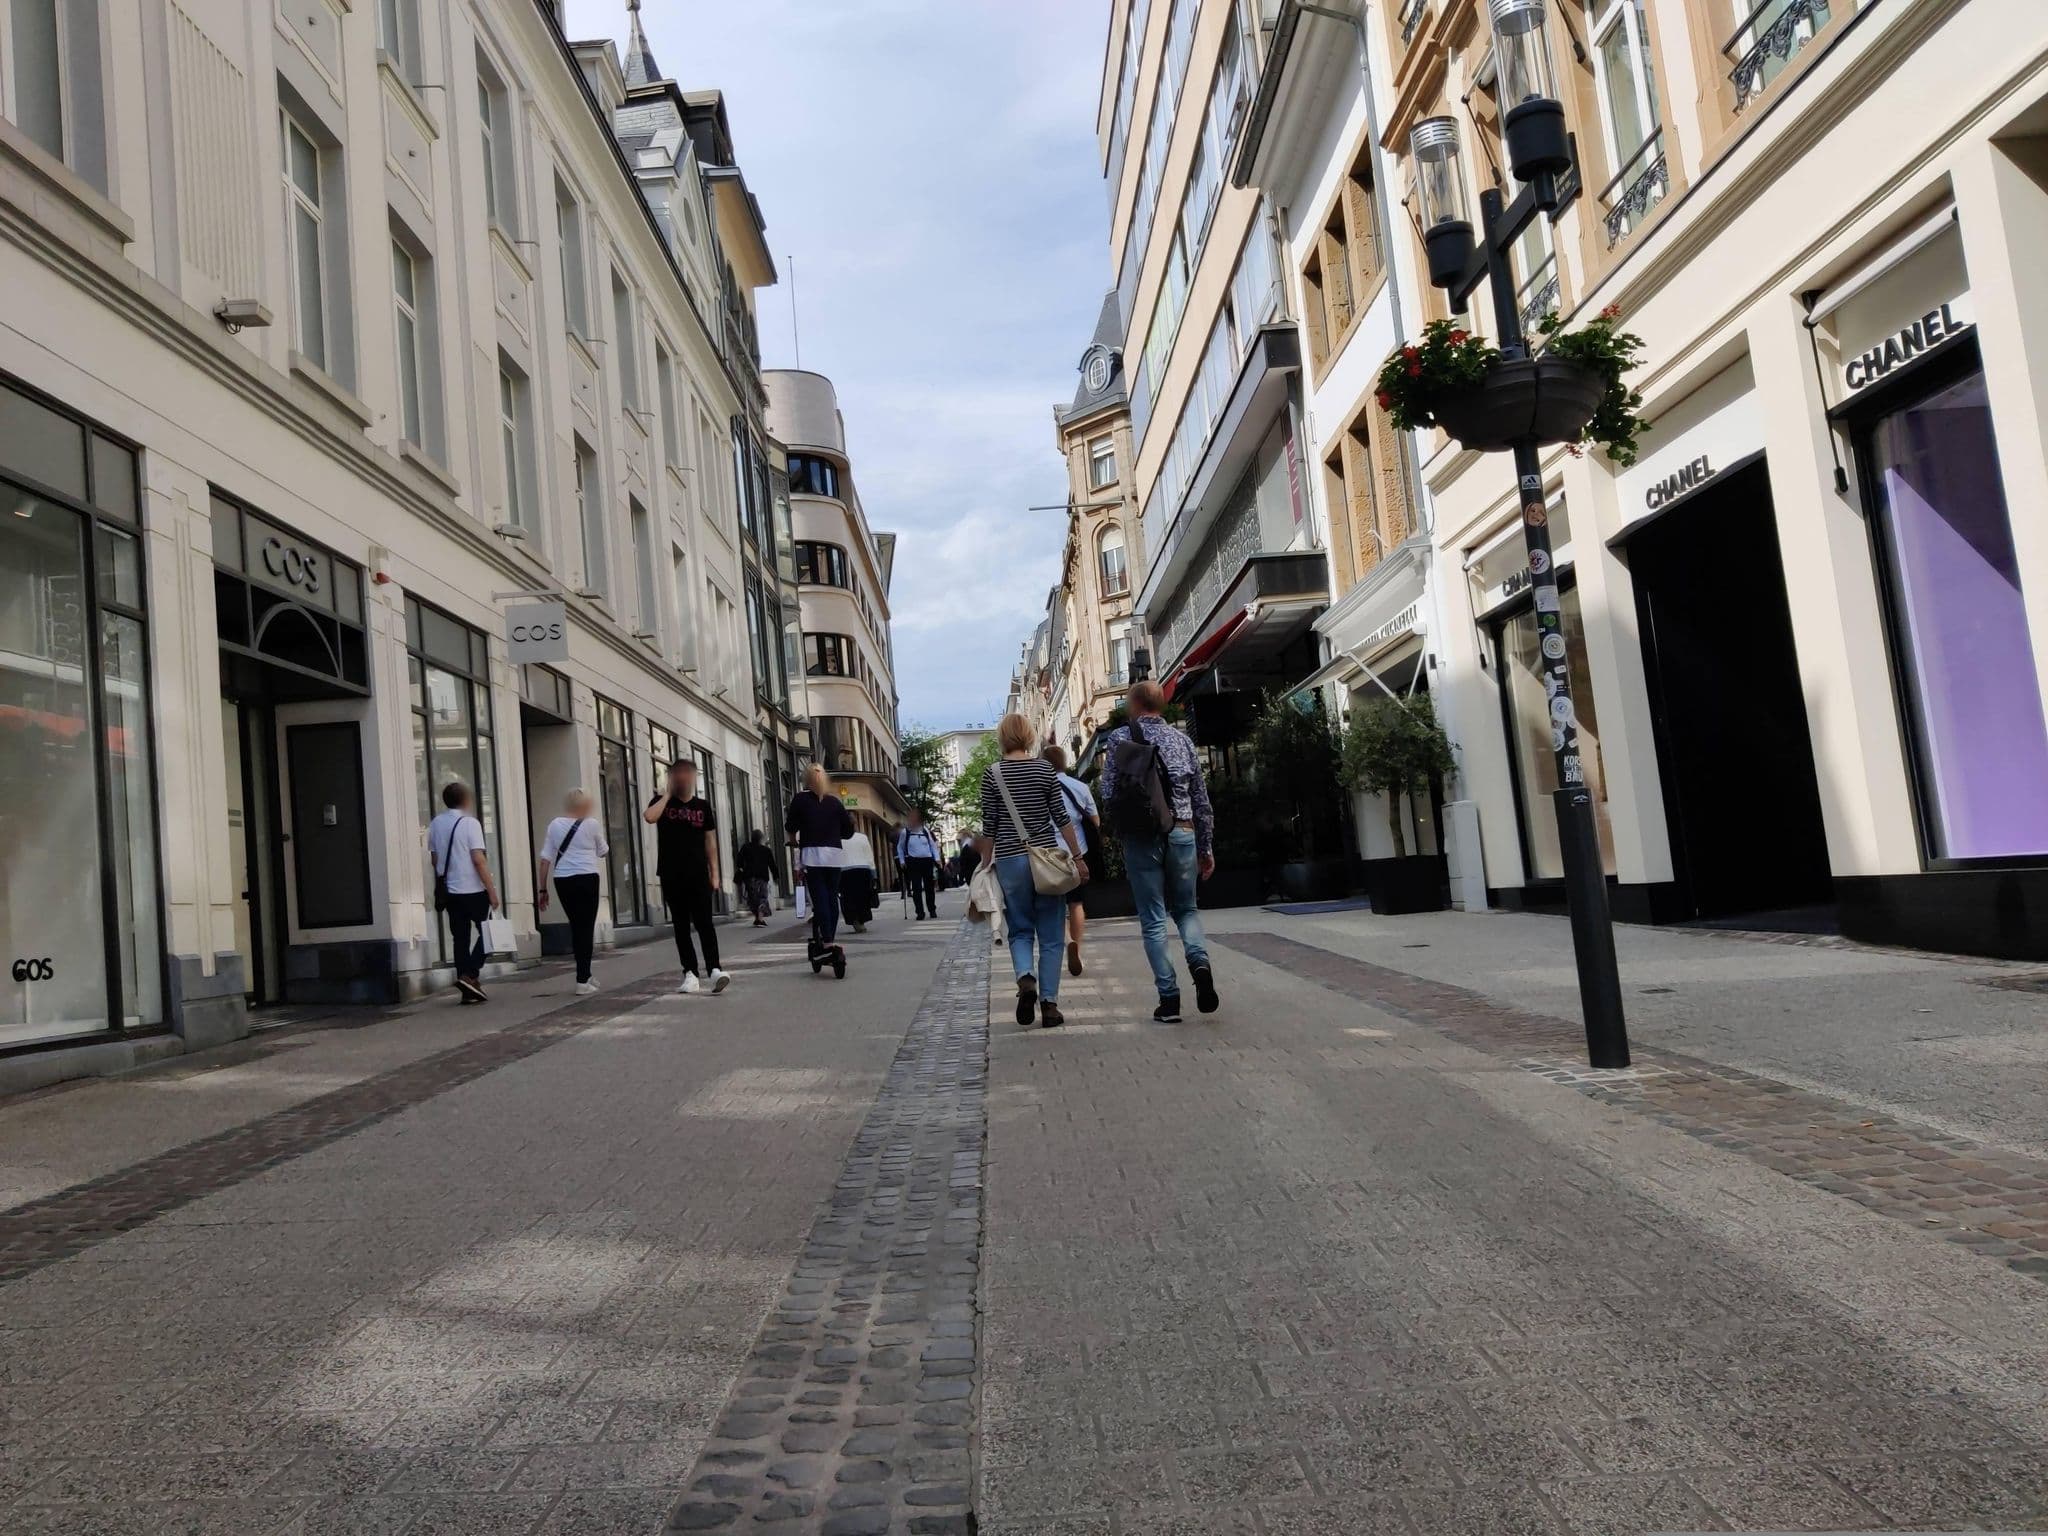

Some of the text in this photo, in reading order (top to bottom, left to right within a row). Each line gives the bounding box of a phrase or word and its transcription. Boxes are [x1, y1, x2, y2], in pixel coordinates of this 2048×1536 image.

[1845, 303, 1963, 390] CHANEL
[1646, 454, 1716, 510] CHANEL
[262, 537, 320, 594] COS
[1503, 566, 1532, 597] CHAN
[512, 623, 562, 643] COS
[12, 957, 54, 983] COS
